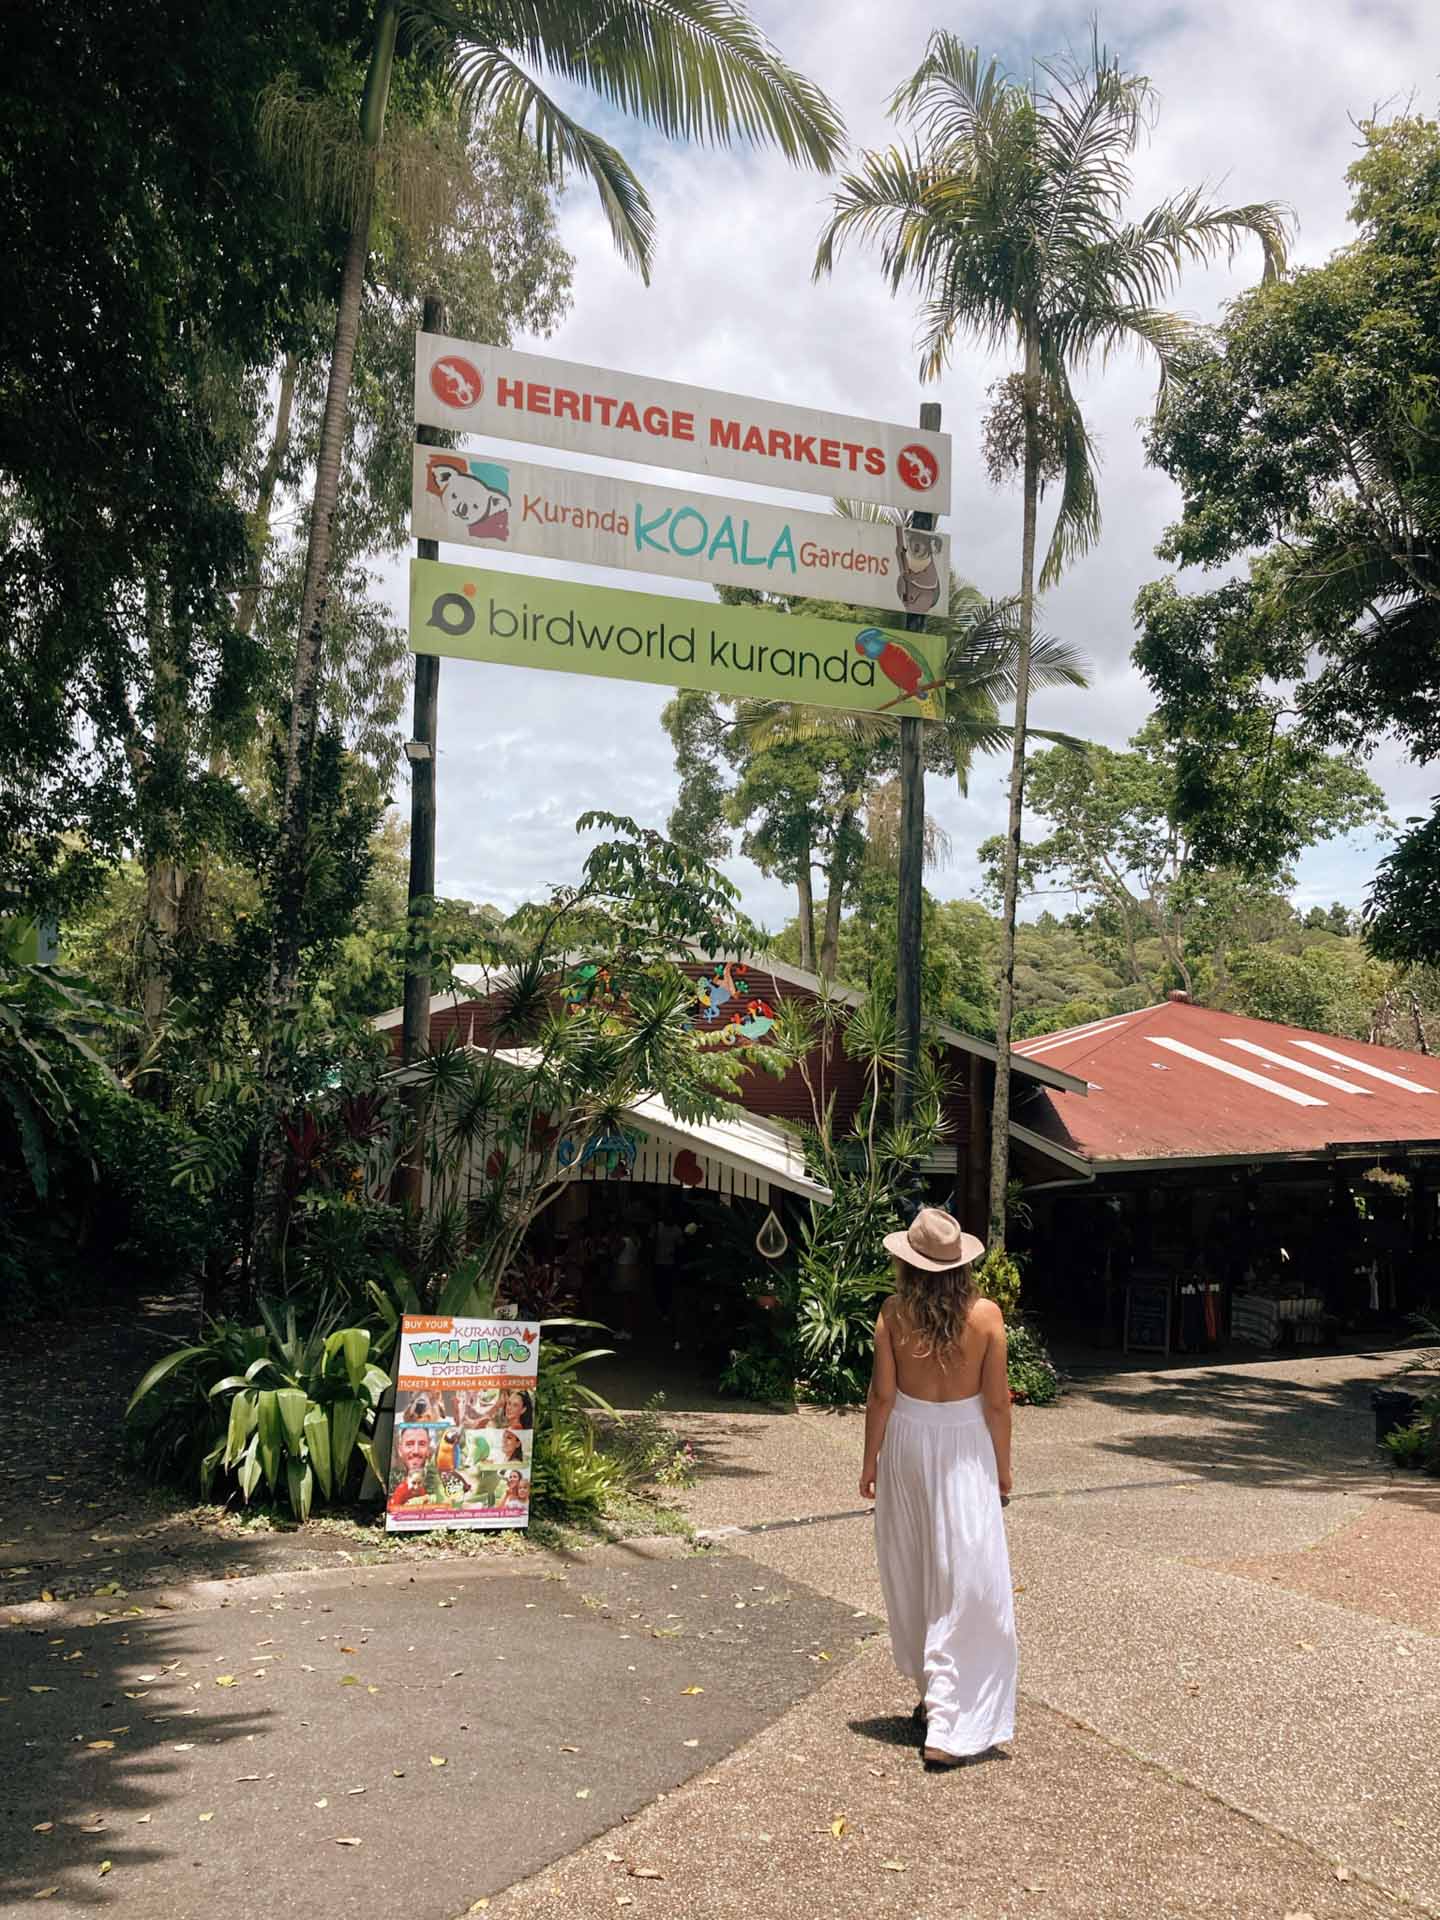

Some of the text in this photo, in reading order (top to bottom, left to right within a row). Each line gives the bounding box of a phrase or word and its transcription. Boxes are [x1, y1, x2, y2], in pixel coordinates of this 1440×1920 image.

[497, 377, 886, 476] HERITAGE MARKETS
[522, 495, 890, 577] Kuranda KOALA Gardens
[489, 600, 875, 687] birdworld kuranda
[404, 1319, 449, 1329] BUY YOUR
[454, 1326, 522, 1337] KURANDA
[409, 1338, 531, 1366] Wildlife
[432, 1365, 507, 1375] EXPERIENCE
[400, 1380, 429, 1388] TICKETS
